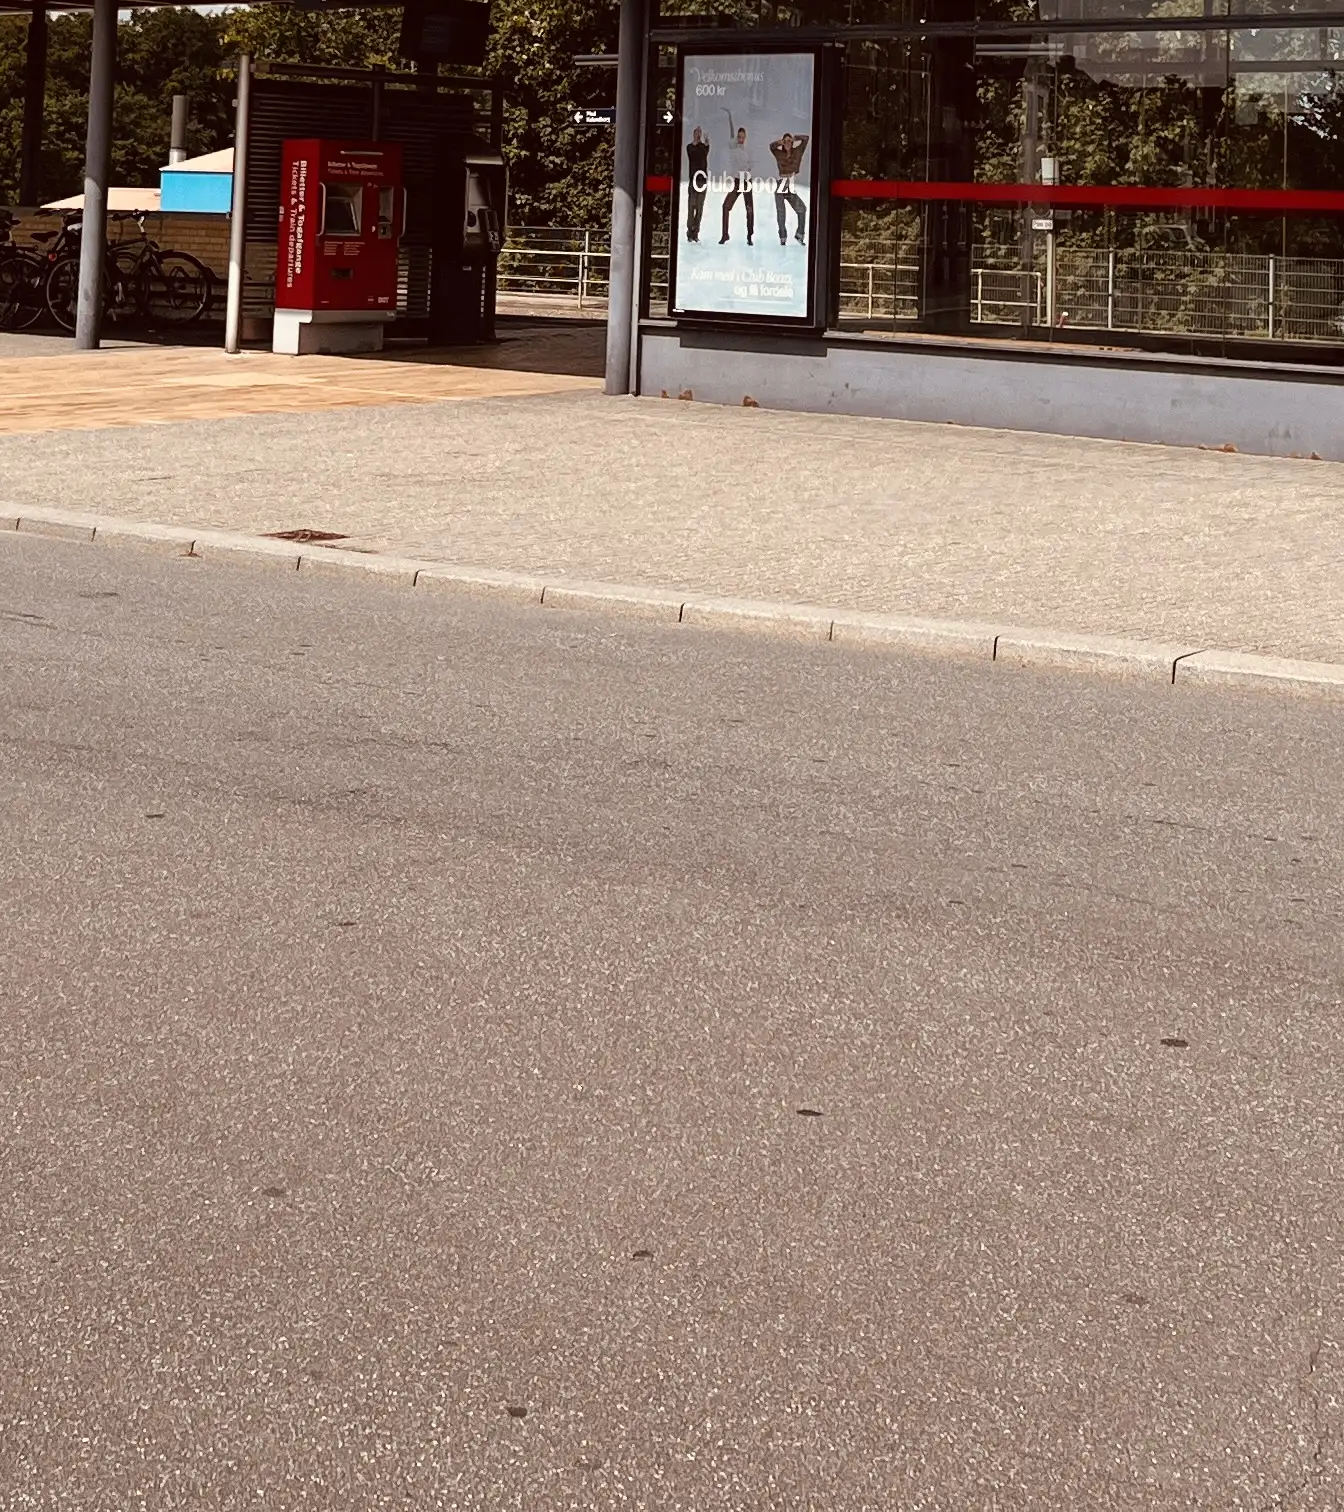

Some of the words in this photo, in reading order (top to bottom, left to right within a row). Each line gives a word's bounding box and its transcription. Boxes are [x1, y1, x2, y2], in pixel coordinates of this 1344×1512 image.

[696, 84, 716, 97] 600
[693, 170, 735, 193] Club
[737, 170, 797, 194] Boozt
